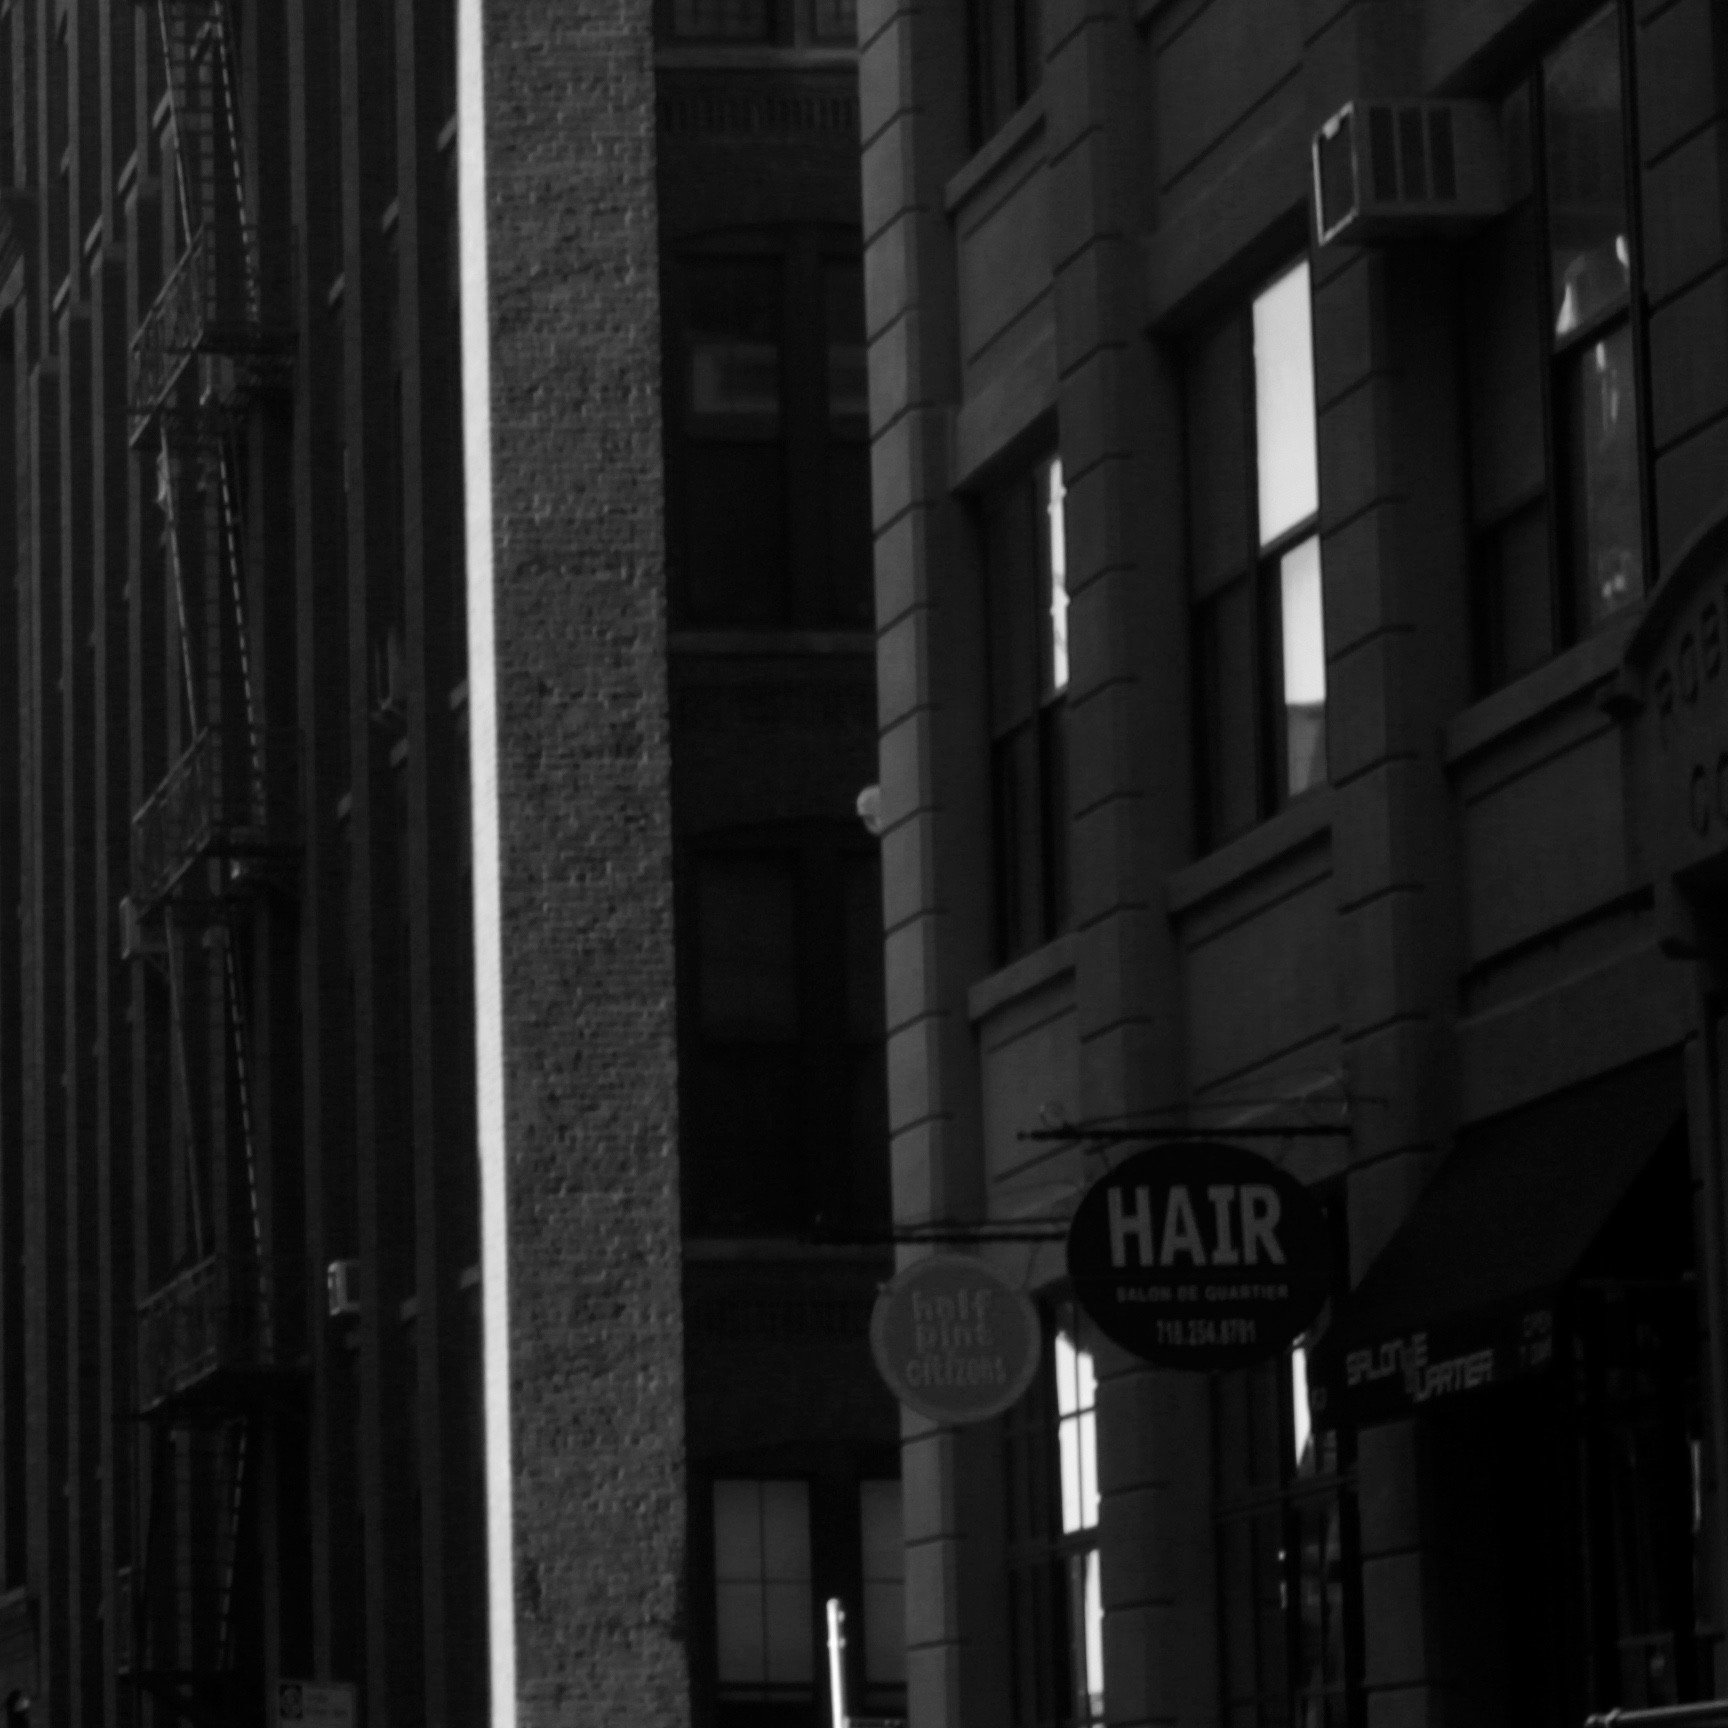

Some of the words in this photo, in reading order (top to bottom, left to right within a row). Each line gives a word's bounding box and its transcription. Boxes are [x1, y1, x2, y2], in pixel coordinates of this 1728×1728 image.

[1654, 594, 1728, 752] ROB
[1106, 1183, 1286, 1267] HAIR
[911, 1288, 992, 1321] half
[1115, 1285, 1172, 1303] SALON
[1204, 1282, 1289, 1302] QUARTIER
[915, 1320, 993, 1354] pint
[905, 1353, 1007, 1388] citizens
